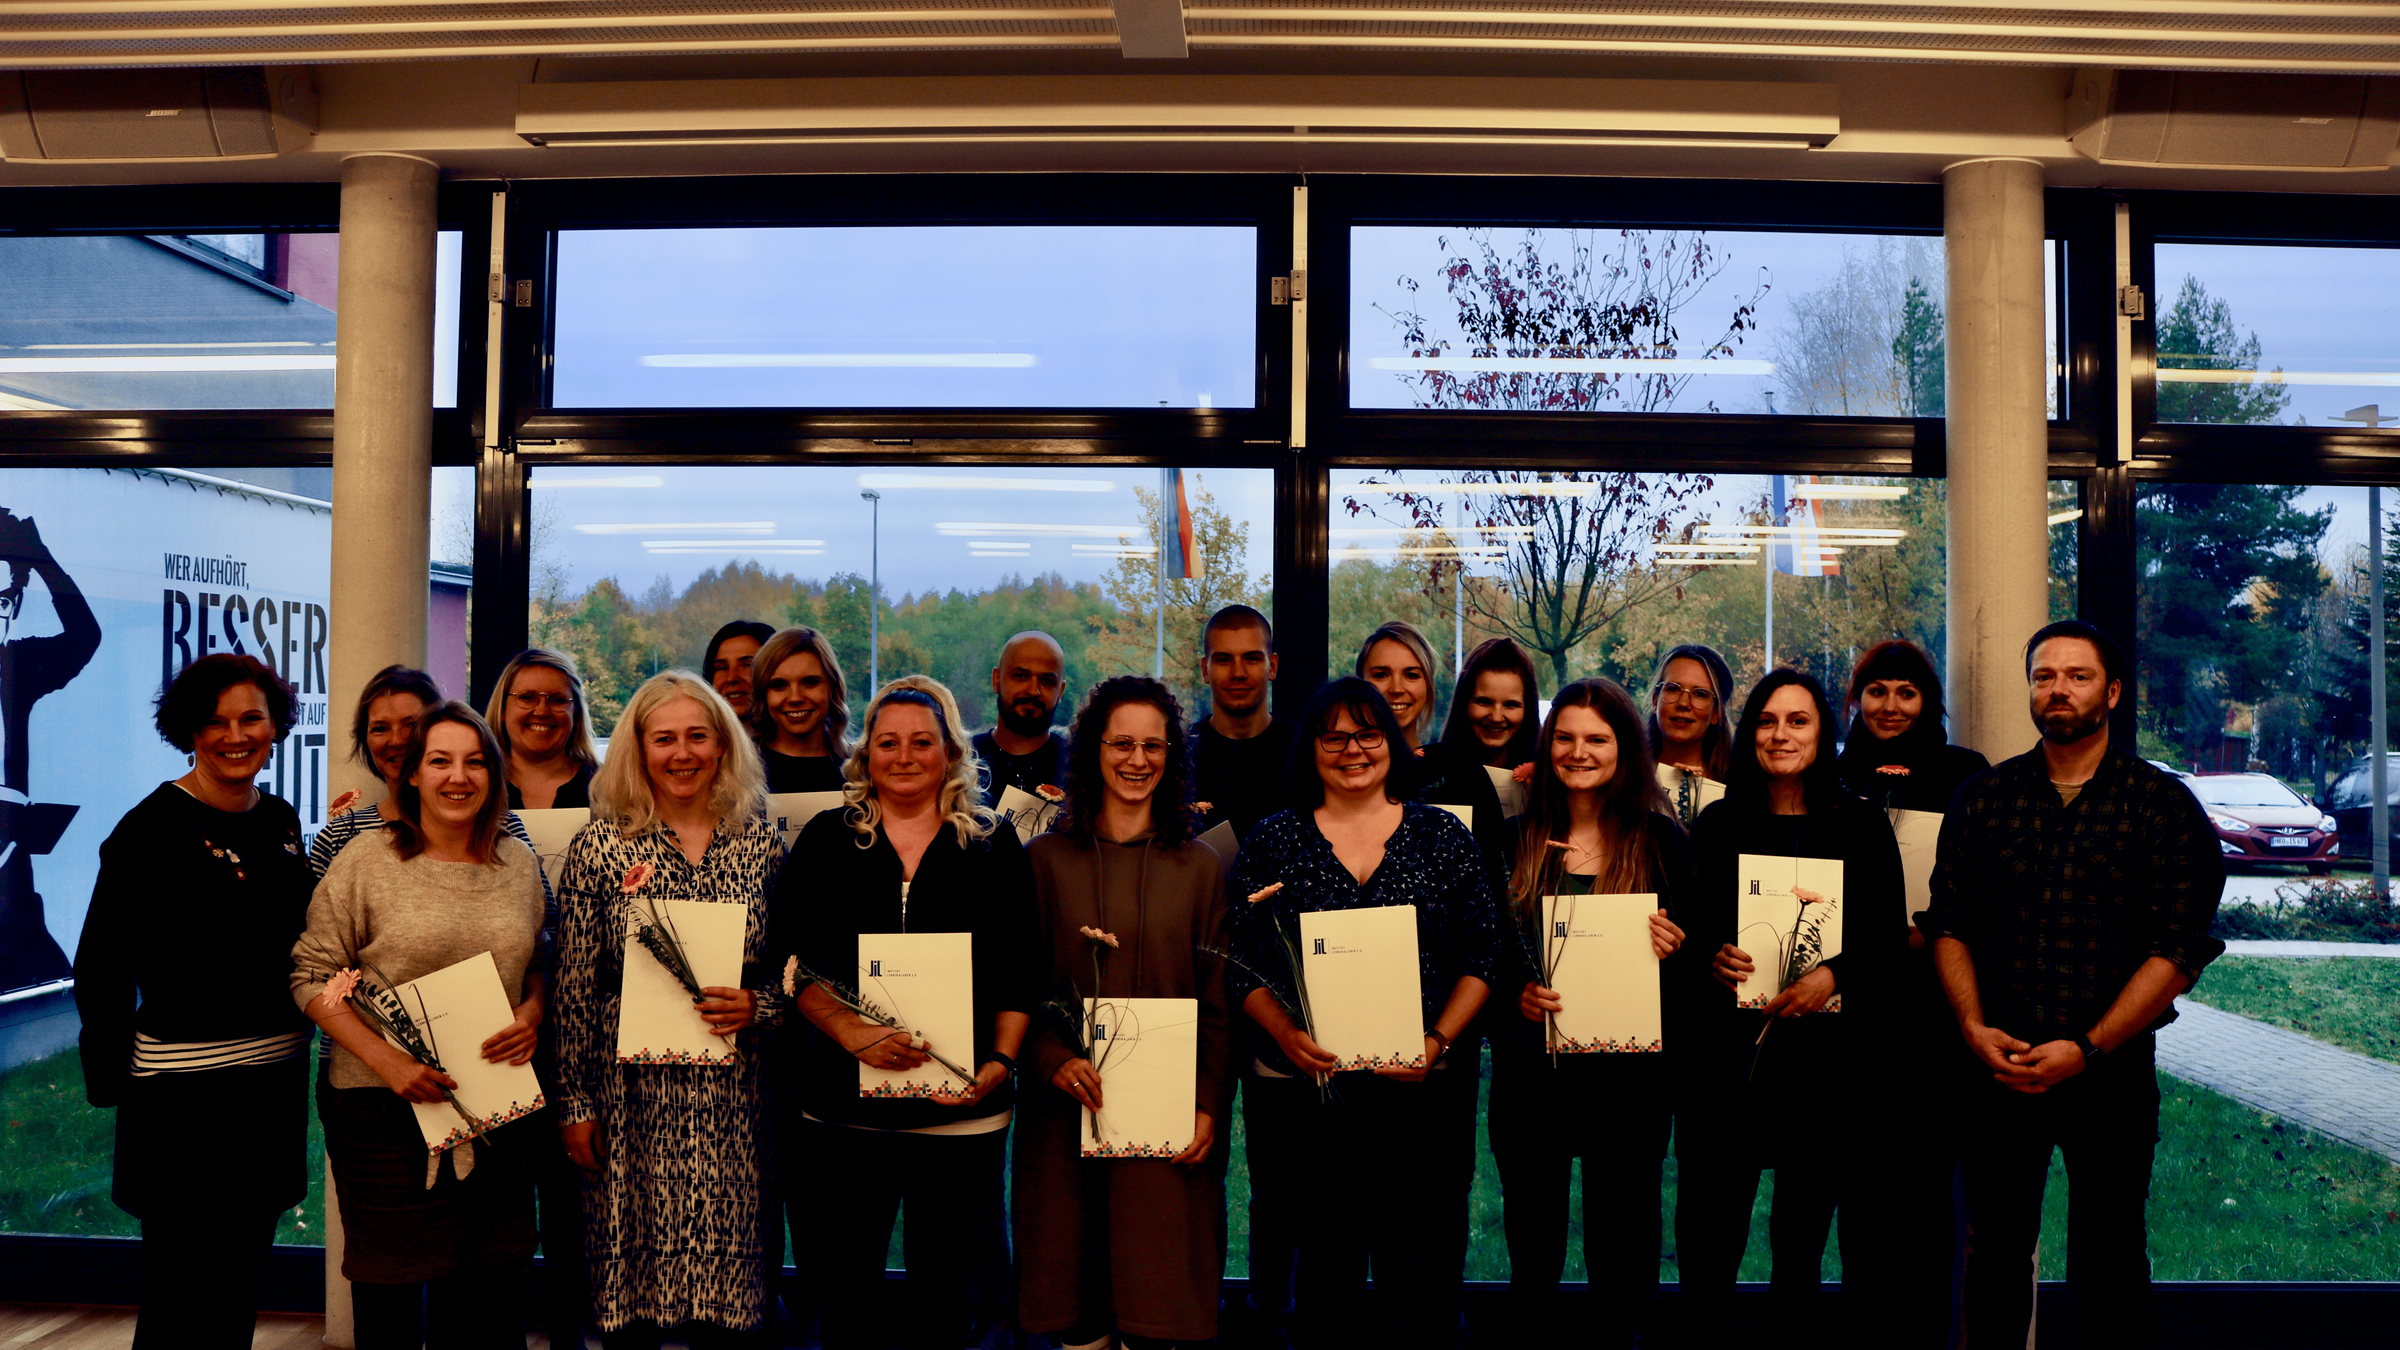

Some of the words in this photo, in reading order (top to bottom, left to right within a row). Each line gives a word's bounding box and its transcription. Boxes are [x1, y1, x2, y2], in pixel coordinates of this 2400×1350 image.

[164, 553, 191, 581] WER
[192, 554, 250, 590] AUFHÖRT,
[162, 588, 327, 694] BESSER
[307, 702, 326, 725] AUF
